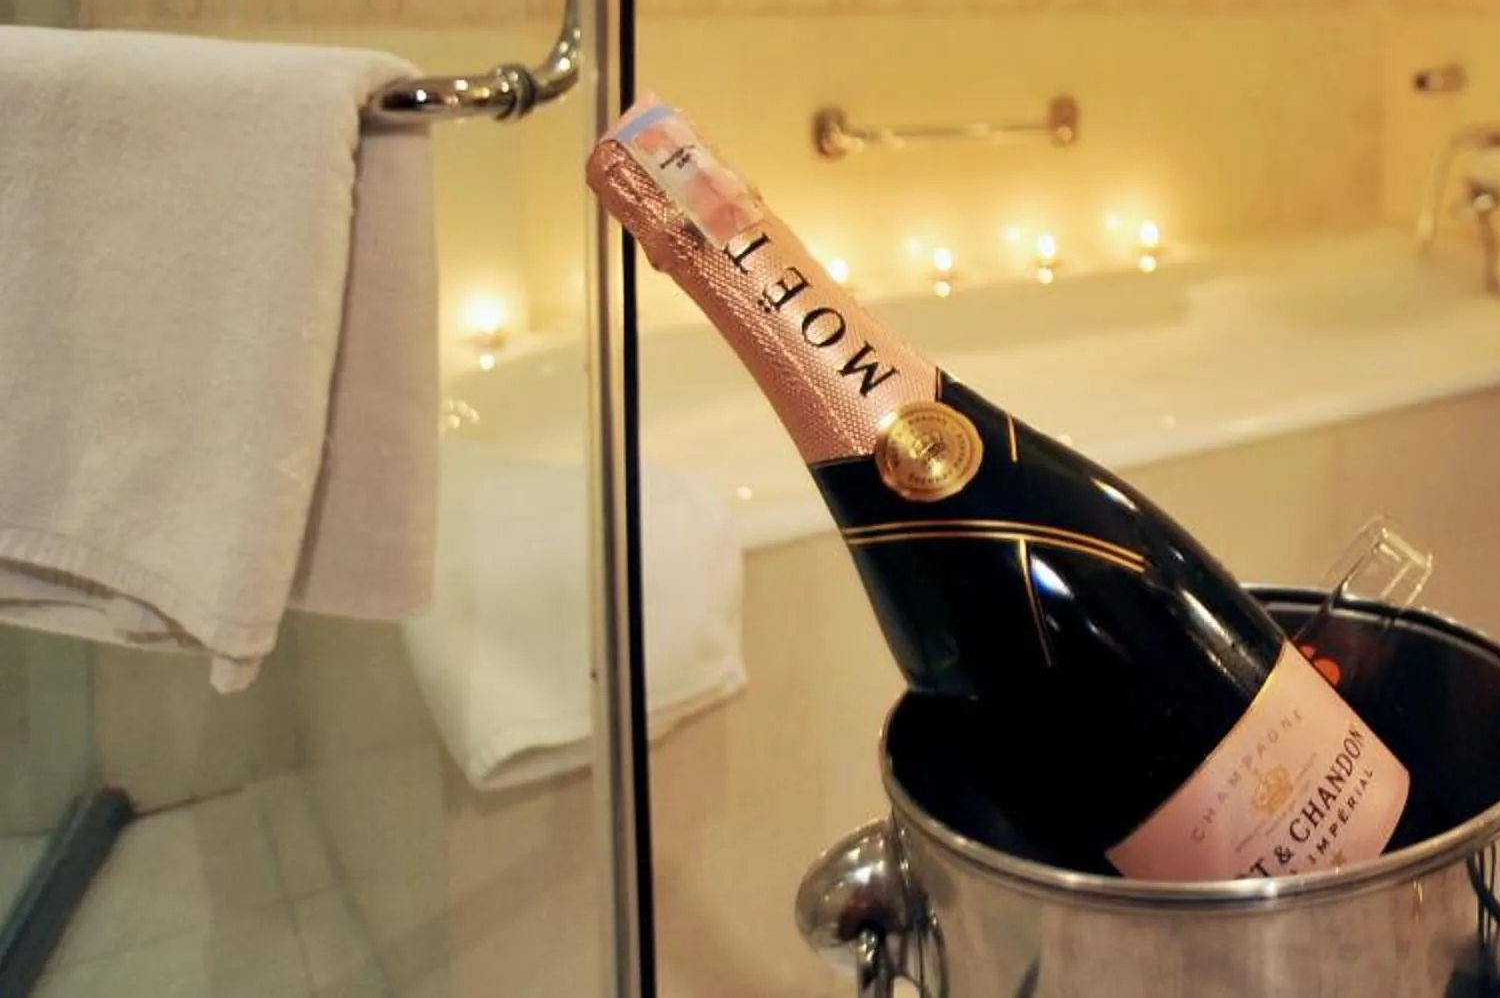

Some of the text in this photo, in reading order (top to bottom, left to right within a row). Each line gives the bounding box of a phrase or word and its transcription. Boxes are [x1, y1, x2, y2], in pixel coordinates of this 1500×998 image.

[725, 231, 899, 398] MOËT
[1192, 709, 1303, 843] CHAMPAGNE
[1274, 846, 1295, 865] &
[1289, 729, 1365, 845] CHANDON
